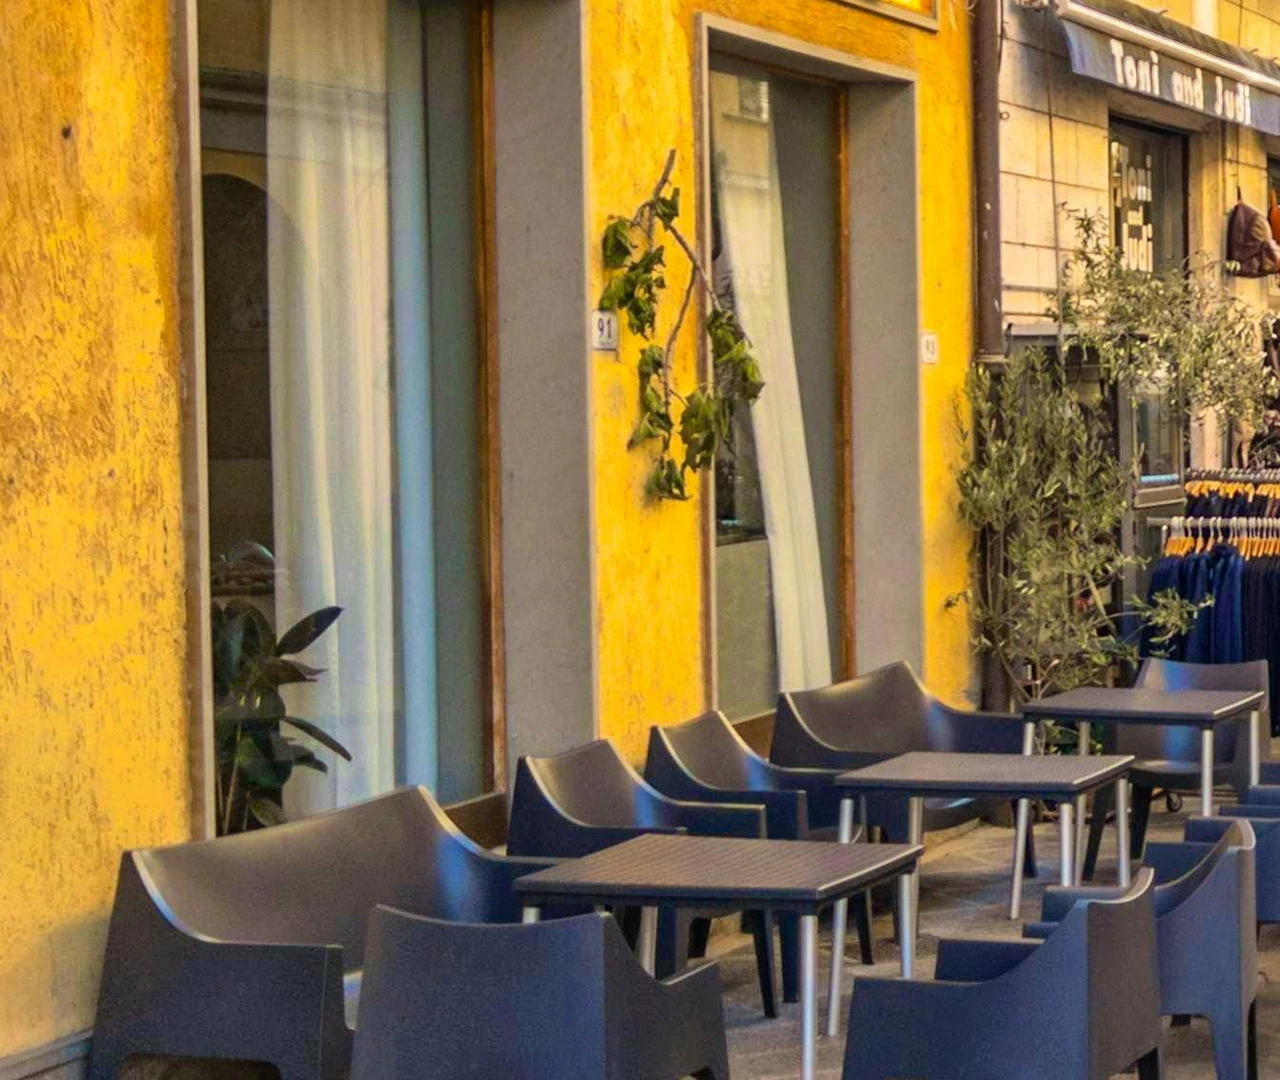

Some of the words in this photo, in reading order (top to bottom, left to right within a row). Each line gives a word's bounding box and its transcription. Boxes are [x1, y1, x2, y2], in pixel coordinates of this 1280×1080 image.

[1110, 38, 1160, 96] Toni
[1171, 67, 1204, 110] and
[597, 317, 612, 338] 91
